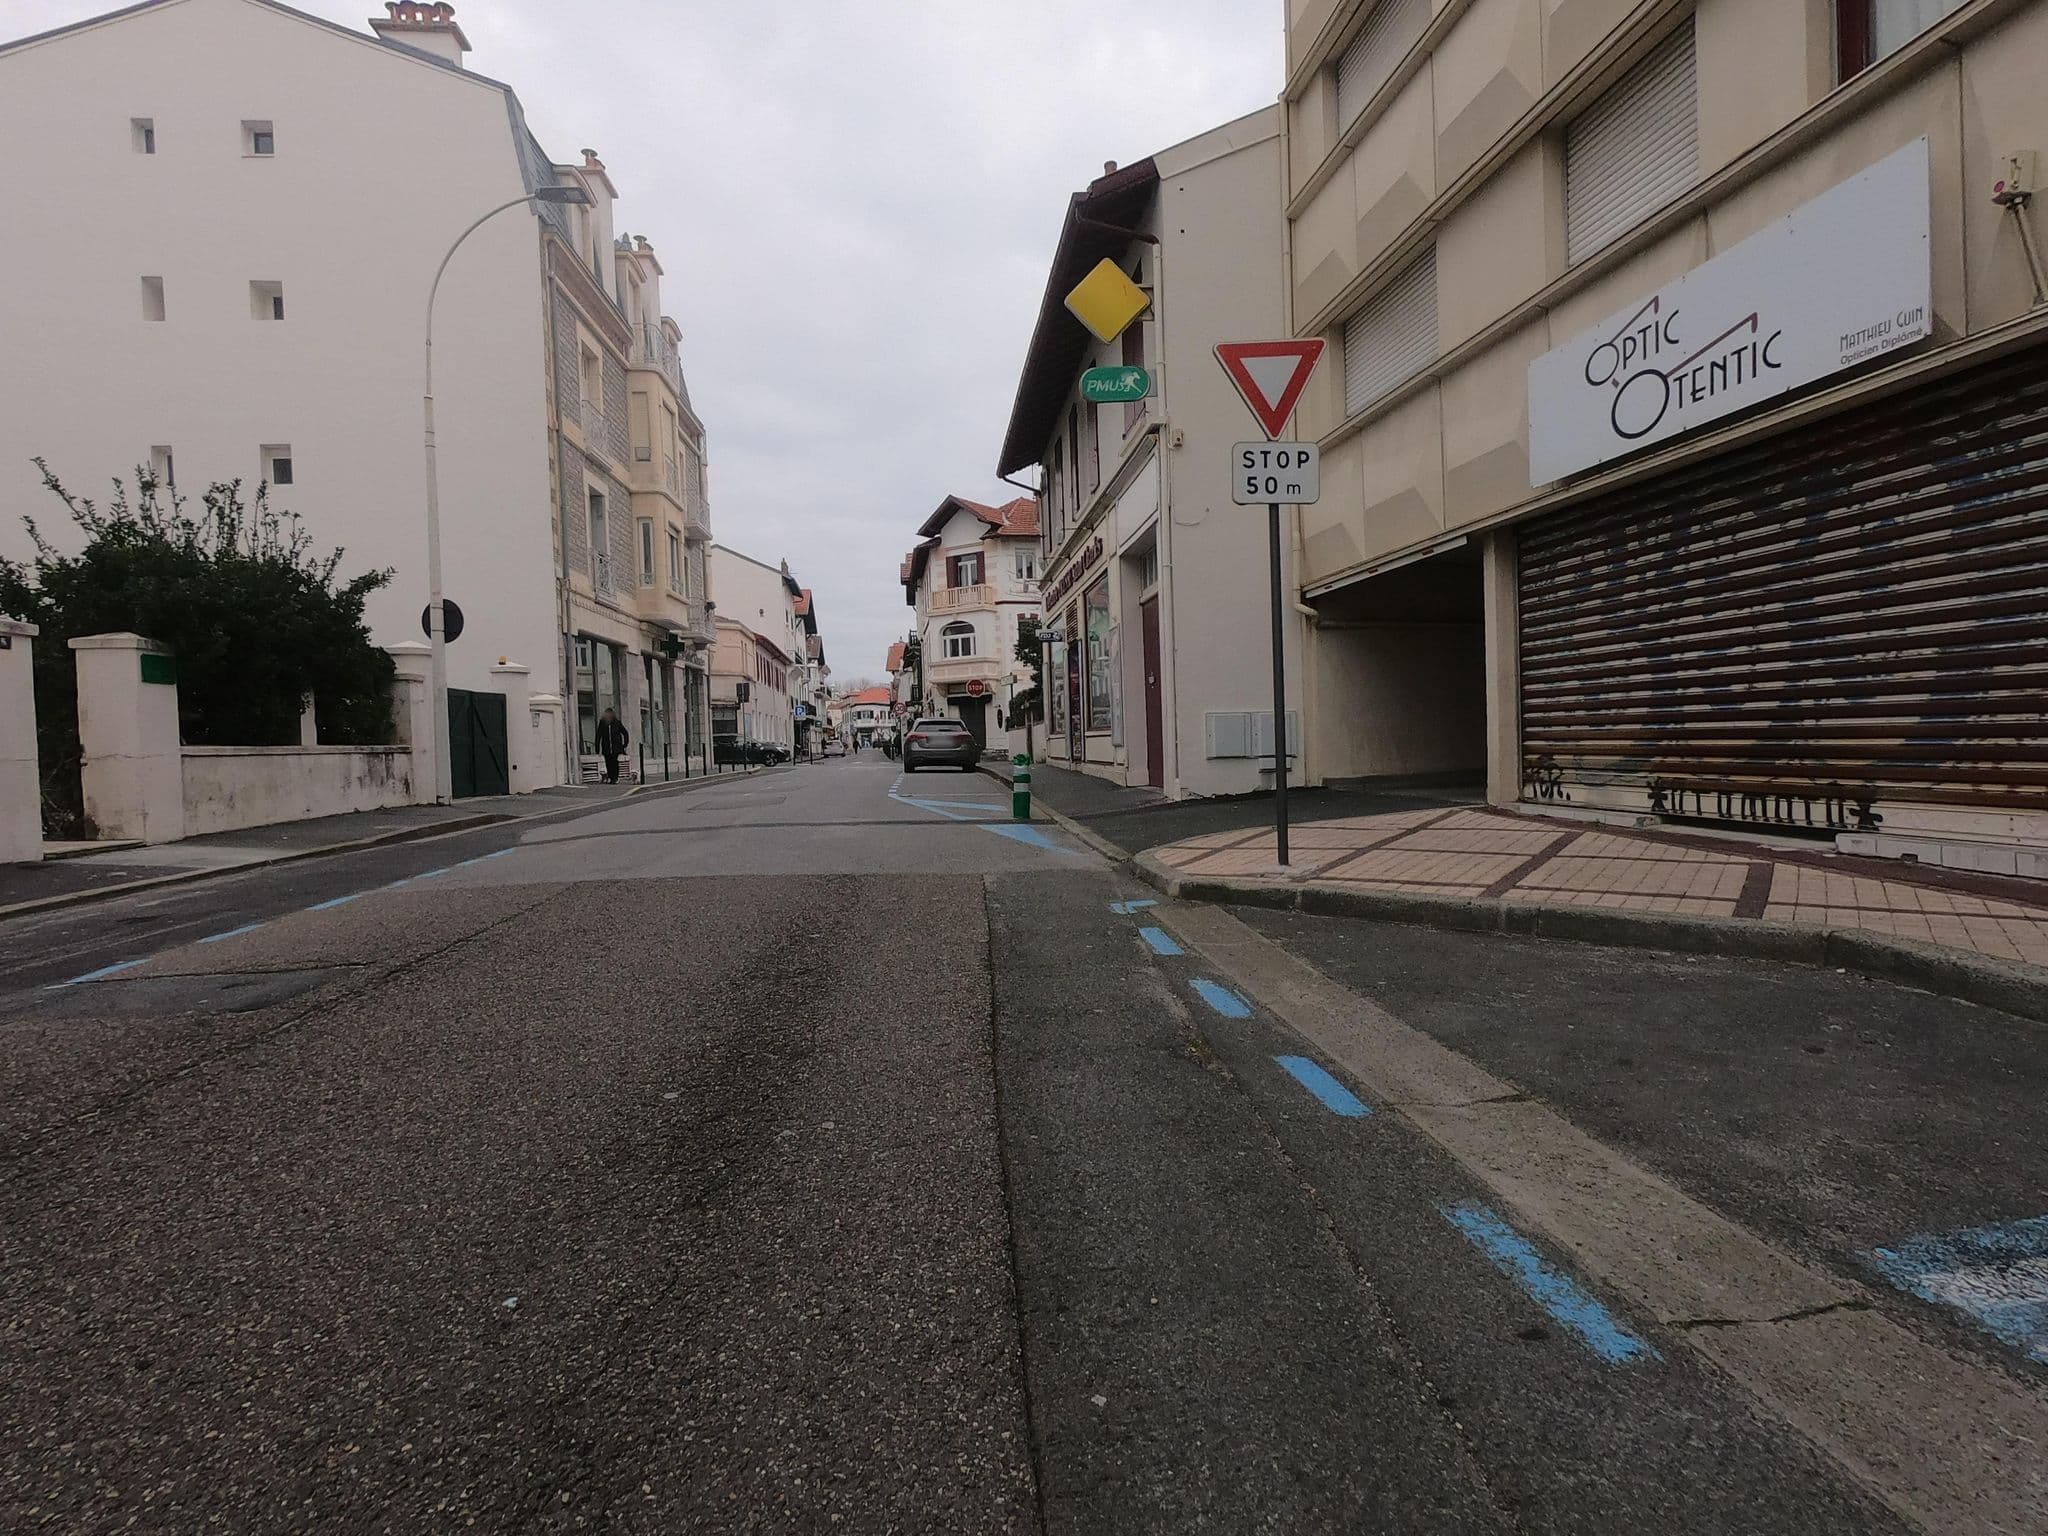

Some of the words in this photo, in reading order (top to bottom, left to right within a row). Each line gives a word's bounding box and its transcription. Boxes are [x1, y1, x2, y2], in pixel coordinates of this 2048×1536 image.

[1839, 319, 1892, 352] MATTHIEU
[1585, 309, 1681, 387] OPTIC
[1840, 344, 1880, 365] Opticien
[1086, 378, 1124, 393] PMU
[1611, 329, 1782, 440] OTENTIC
[1242, 450, 1311, 469] STOP
[1246, 476, 1278, 495] 50
[1286, 483, 1301, 495] m
[796, 707, 803, 717] P
